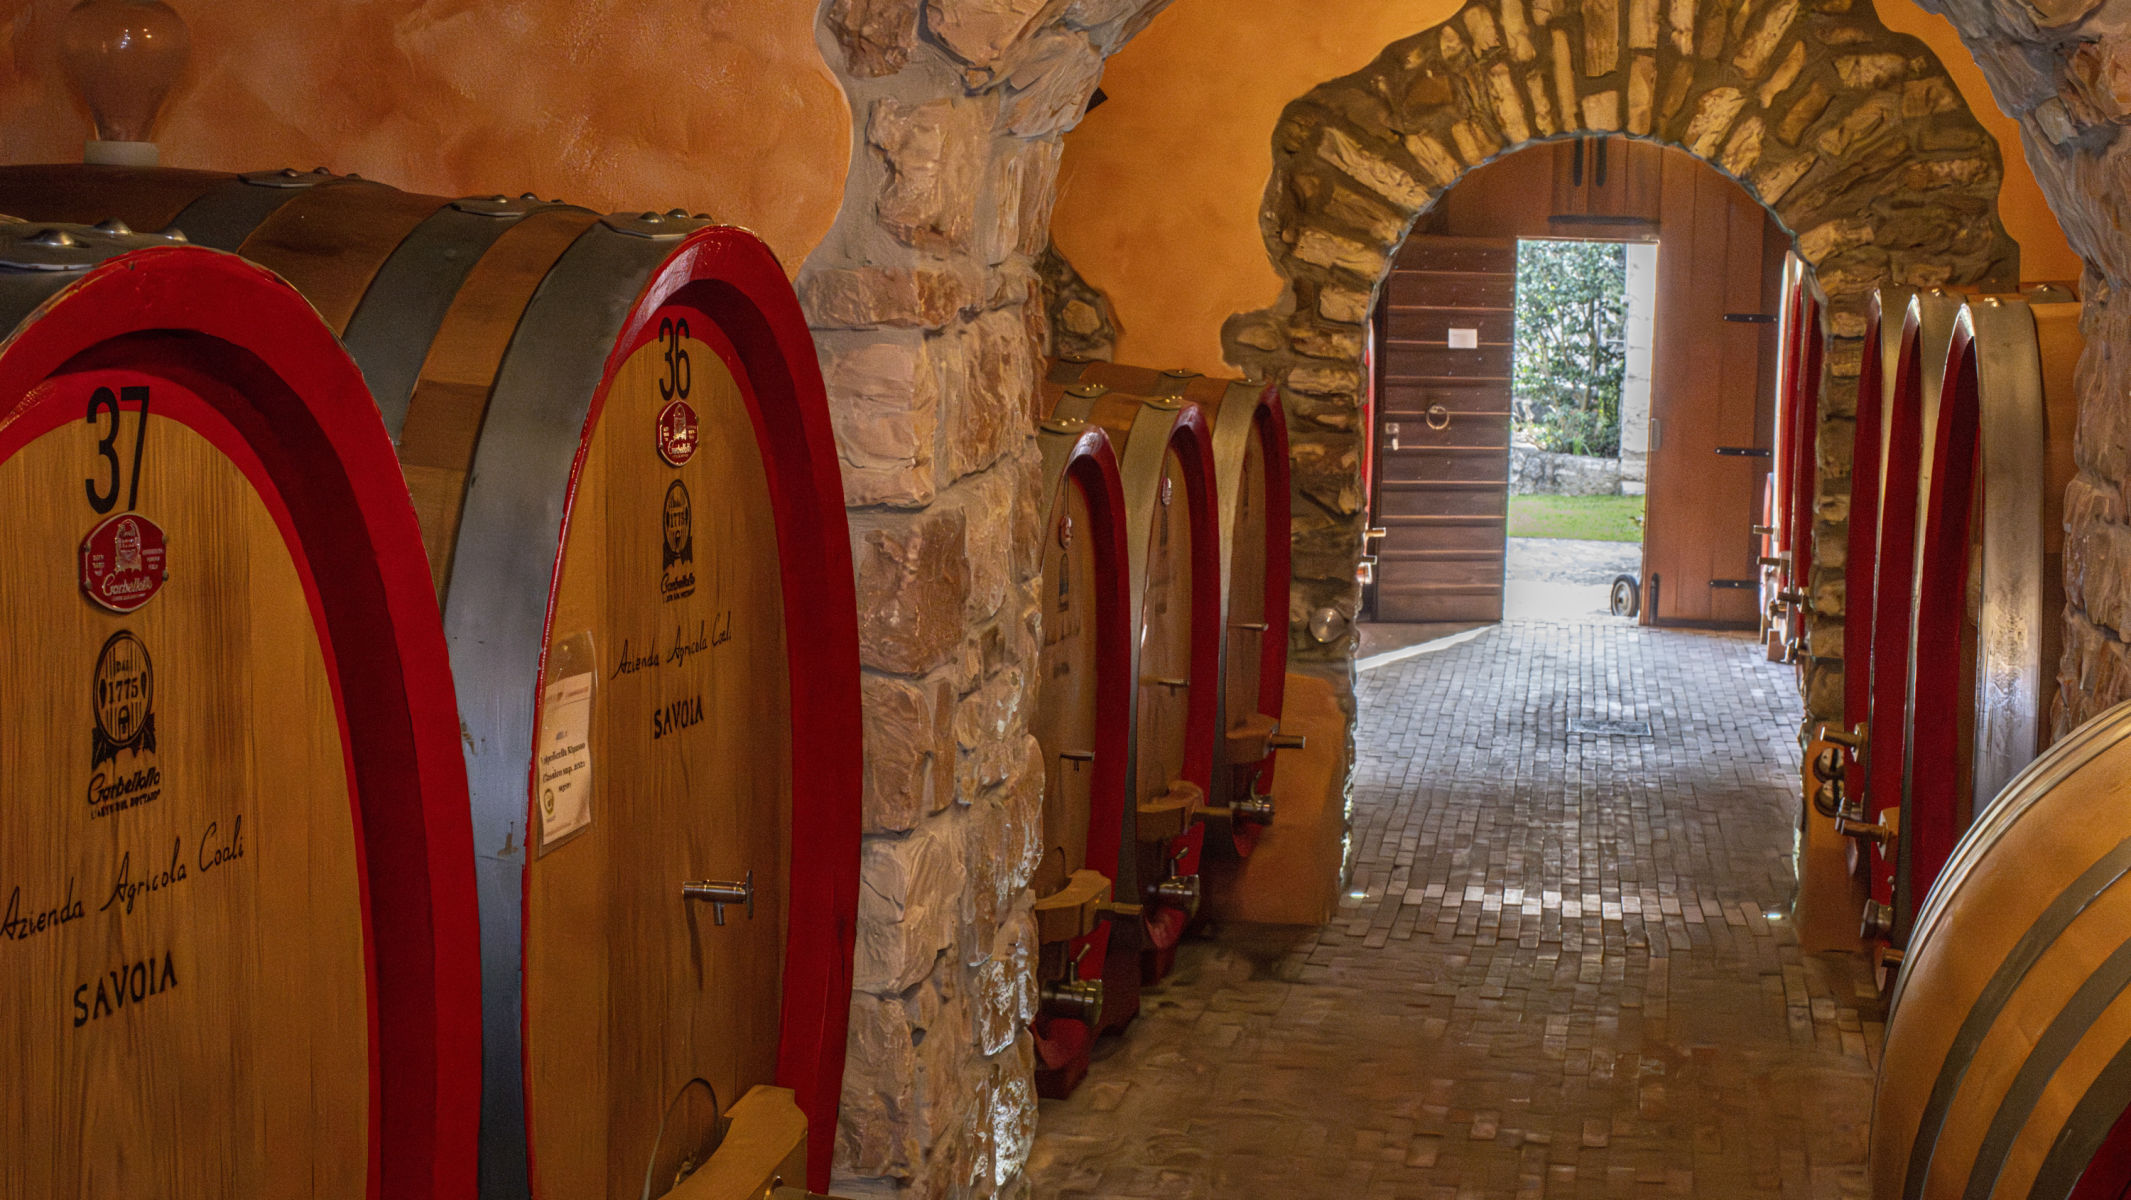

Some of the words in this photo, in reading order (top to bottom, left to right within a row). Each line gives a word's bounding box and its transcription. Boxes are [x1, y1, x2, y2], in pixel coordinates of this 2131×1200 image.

[659, 317, 691, 401] 36
[85, 386, 150, 514] 37
[611, 637, 660, 680] Azienda
[667, 619, 708, 668] Agricola
[109, 677, 139, 704] 1775
[654, 695, 704, 739] SAVOIA
[0, 876, 85, 940] Azienda
[100, 836, 187, 915] Agricola
[199, 814, 244, 872] Coali
[73, 950, 178, 1028] SAVOIA
